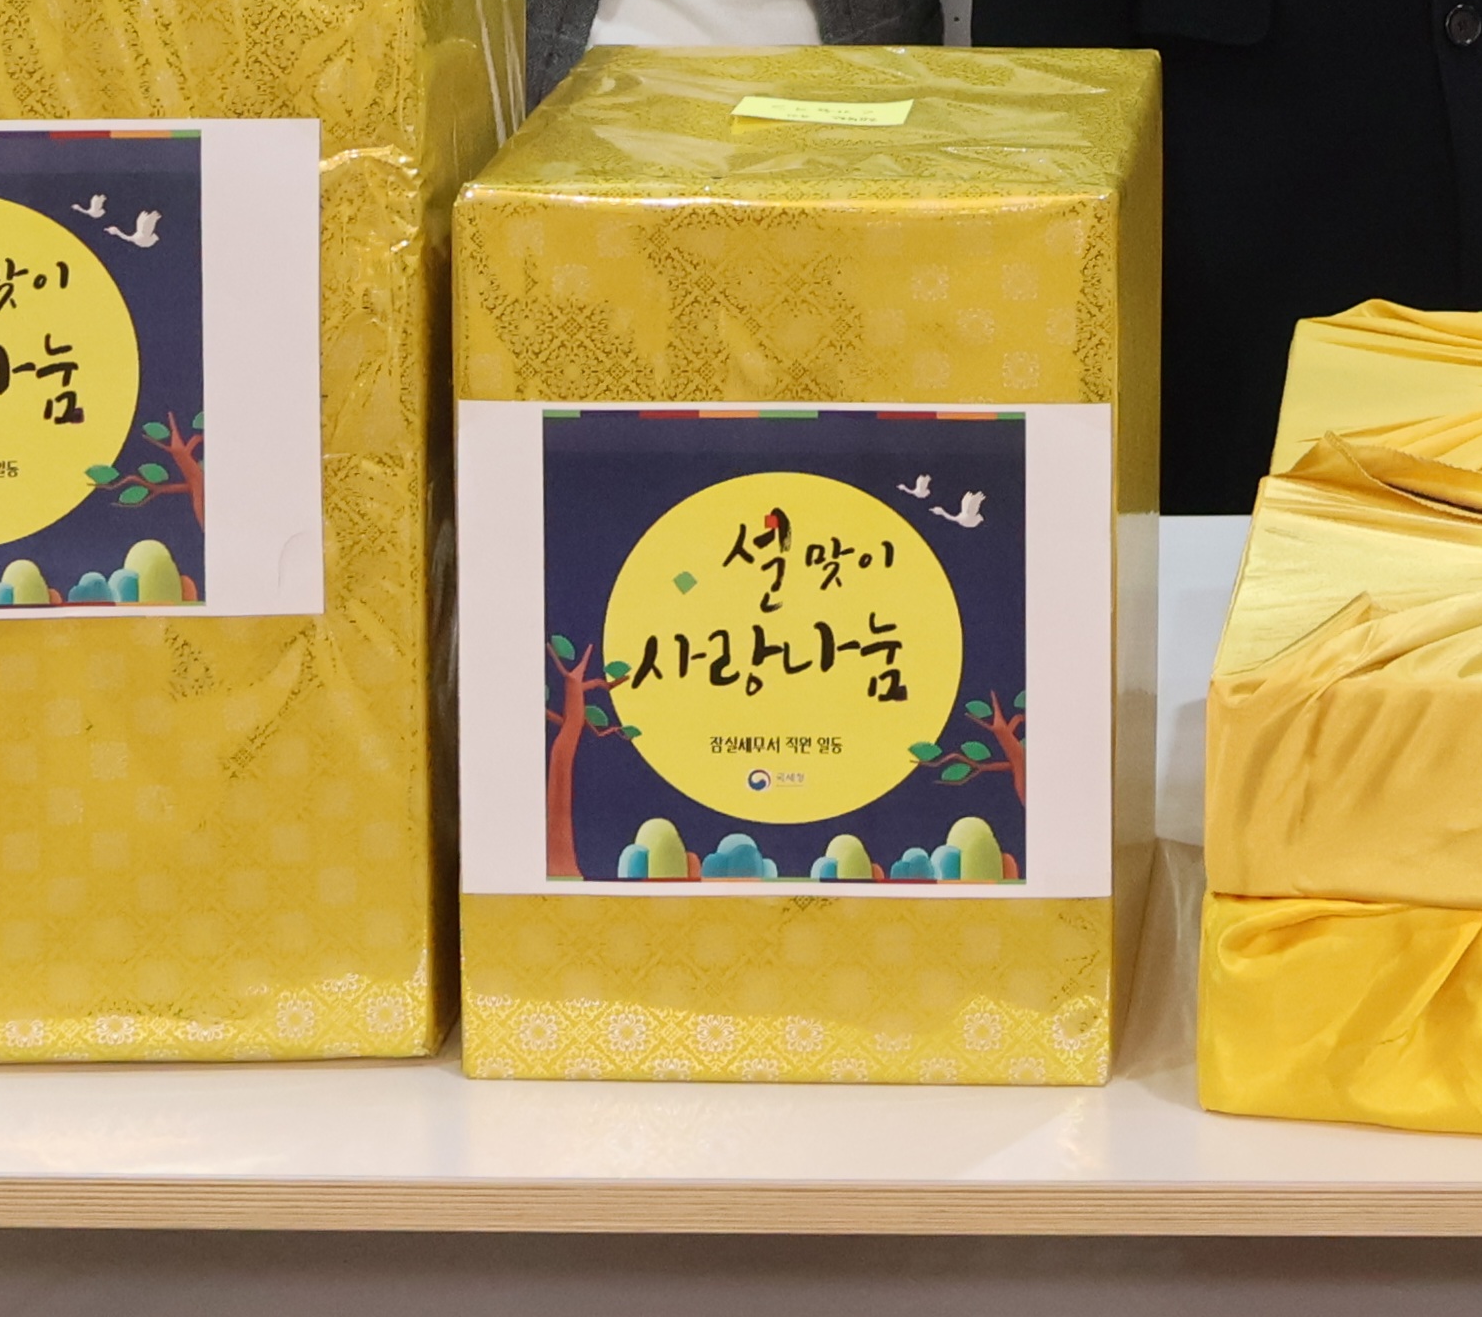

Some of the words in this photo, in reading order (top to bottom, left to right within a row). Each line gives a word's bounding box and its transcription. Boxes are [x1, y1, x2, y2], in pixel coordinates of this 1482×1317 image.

[723, 508, 791, 613] 설
[805, 537, 894, 590] 맞이
[632, 612, 907, 702] 사랑나눔
[710, 737, 780, 753] 잠실세무서
[786, 737, 811, 753] 직원
[817, 737, 842, 754] 일동
